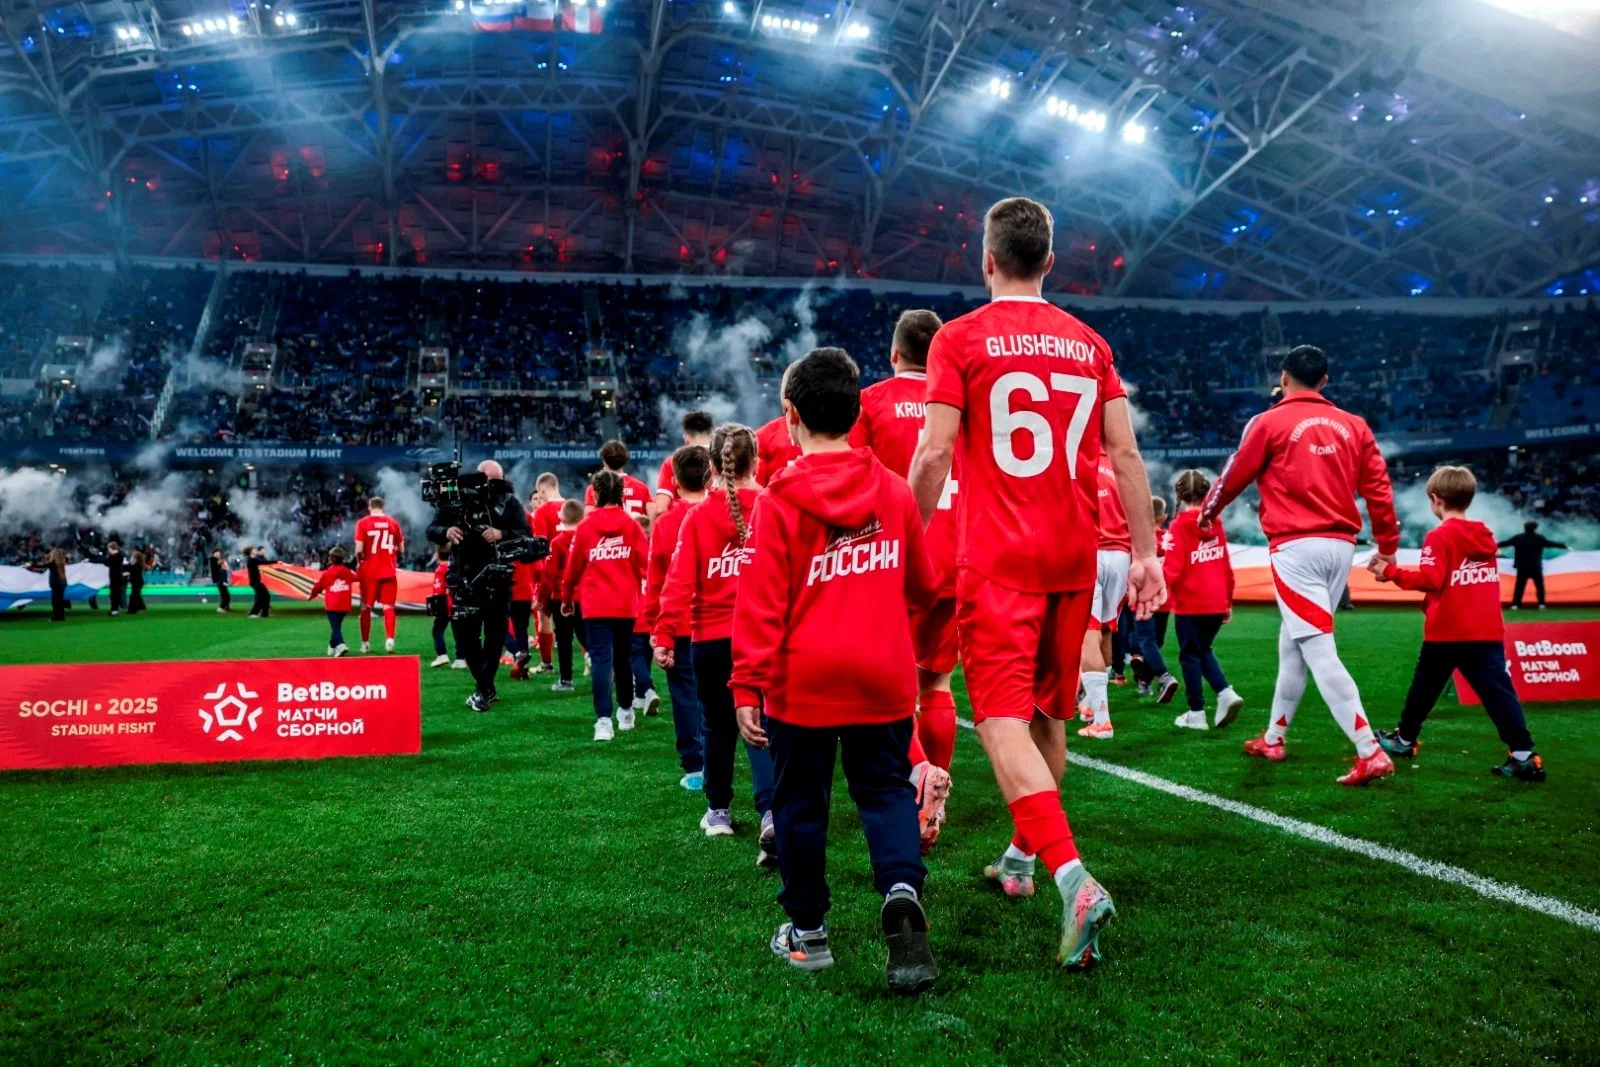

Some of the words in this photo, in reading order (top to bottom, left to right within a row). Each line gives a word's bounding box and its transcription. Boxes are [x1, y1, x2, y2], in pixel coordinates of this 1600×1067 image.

[986, 334, 1096, 365] GLUSHENKOV
[895, 402, 927, 418] KRU
[989, 371, 1098, 480] 67
[1524, 424, 1590, 440] WELCOME
[175, 447, 234, 457] WELCOME
[237, 448, 251, 457] TO
[254, 447, 307, 457] STADIUM
[310, 448, 342, 458] FISHT
[494, 449, 530, 459] ДОБРО
[533, 449, 602, 459] ПОЖАЛОВАТ
[367, 529, 395, 555] 74
[807, 539, 900, 587] РОССИИ
[1514, 640, 1588, 657] BetBoom
[1520, 660, 1561, 672] МАТЧИ
[1524, 669, 1581, 683] СБОРНОЙ
[277, 681, 388, 702] BetBoom
[18, 699, 88, 718] SOCHI
[107, 697, 159, 715] 2025
[277, 707, 338, 722] МАТЧИ
[51, 723, 114, 737] STADIUM
[118, 722, 156, 734] FISHT
[277, 718, 365, 737] СБОРНОЙ
